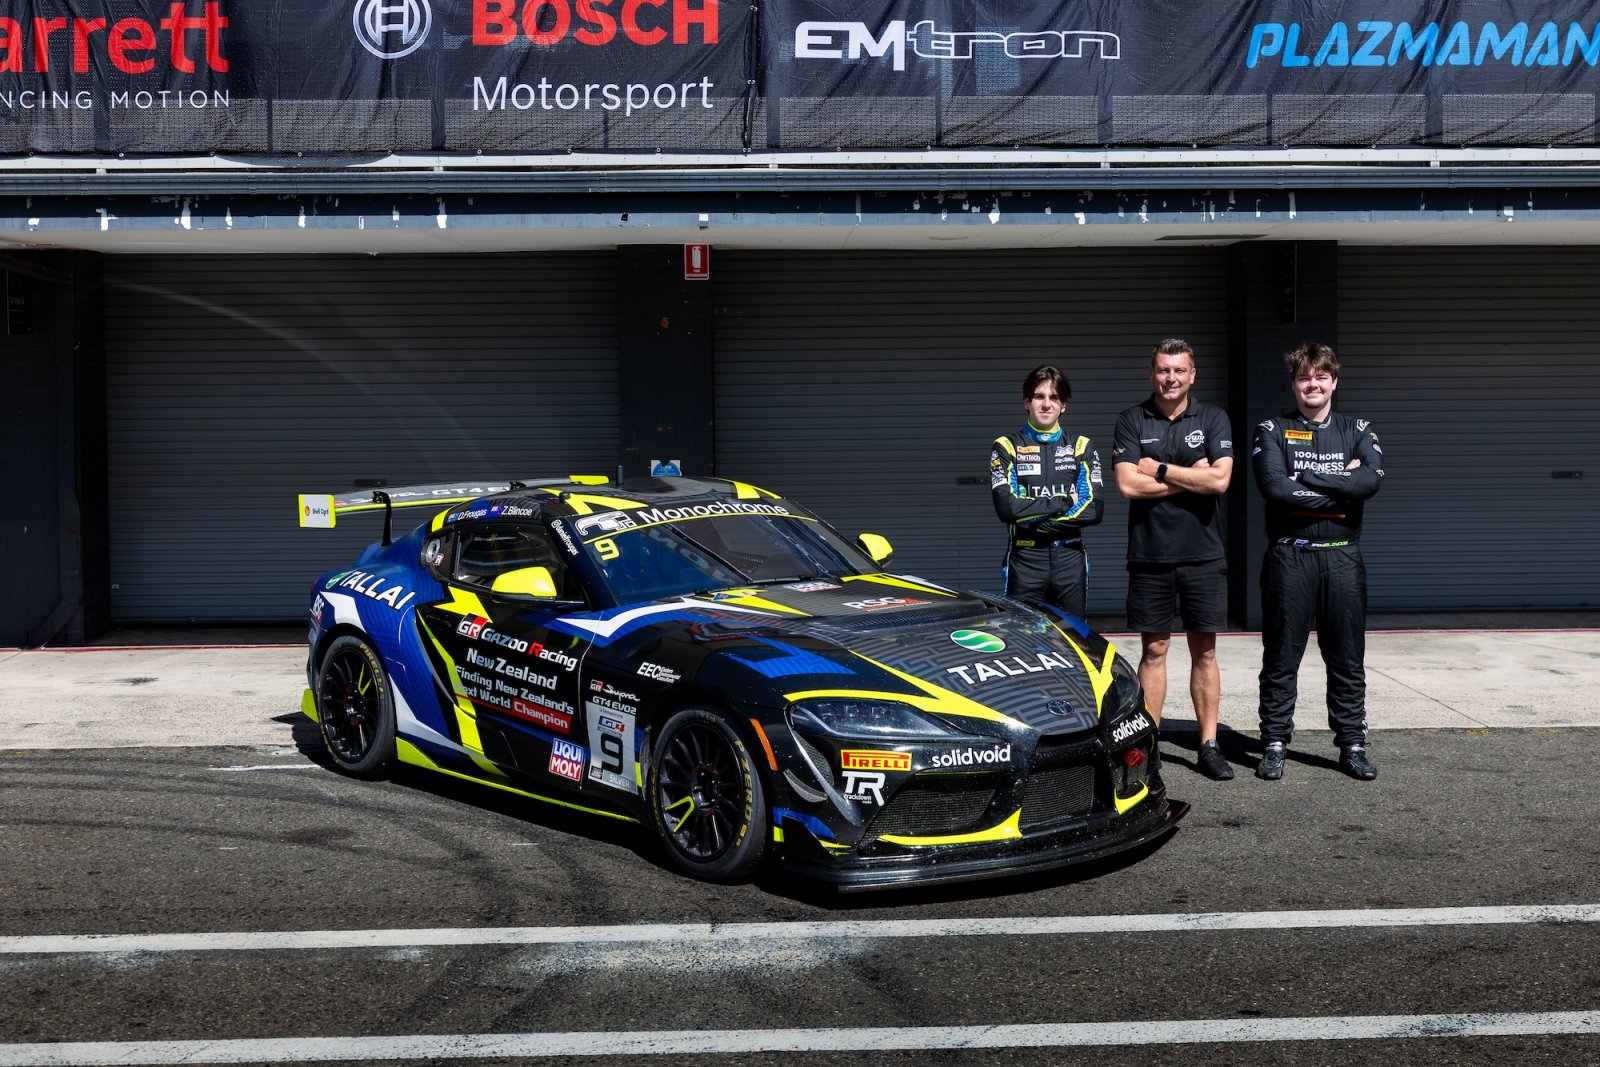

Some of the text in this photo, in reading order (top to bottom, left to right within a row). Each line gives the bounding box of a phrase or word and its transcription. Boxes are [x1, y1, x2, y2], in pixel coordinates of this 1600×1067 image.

[472, 0, 719, 46] BOSCH
[1246, 21, 1600, 68] PLAZMAMAN
[111, 90, 230, 109] MOTION
[473, 76, 714, 117] Motorsport
[1032, 483, 1077, 497] TALLA
[637, 502, 789, 524] Monochrome
[594, 538, 620, 561] 9
[339, 570, 416, 610] TALLAI
[466, 648, 557, 690] New Zealand
[528, 642, 578, 672] Racing
[637, 662, 661, 678] EEC
[947, 652, 1074, 684] TALLAI
[455, 666, 574, 714] Finding New Zealand's
[480, 690, 511, 708] World
[513, 701, 569, 728] Champion
[592, 696, 637, 715] GT4 EVO2
[553, 741, 582, 763] LIQUI
[600, 733, 624, 775] 9
[843, 752, 910, 768] PIRELLI
[551, 757, 581, 778] MOLY
[609, 773, 630, 788] SILVER
[842, 771, 886, 806] TR
